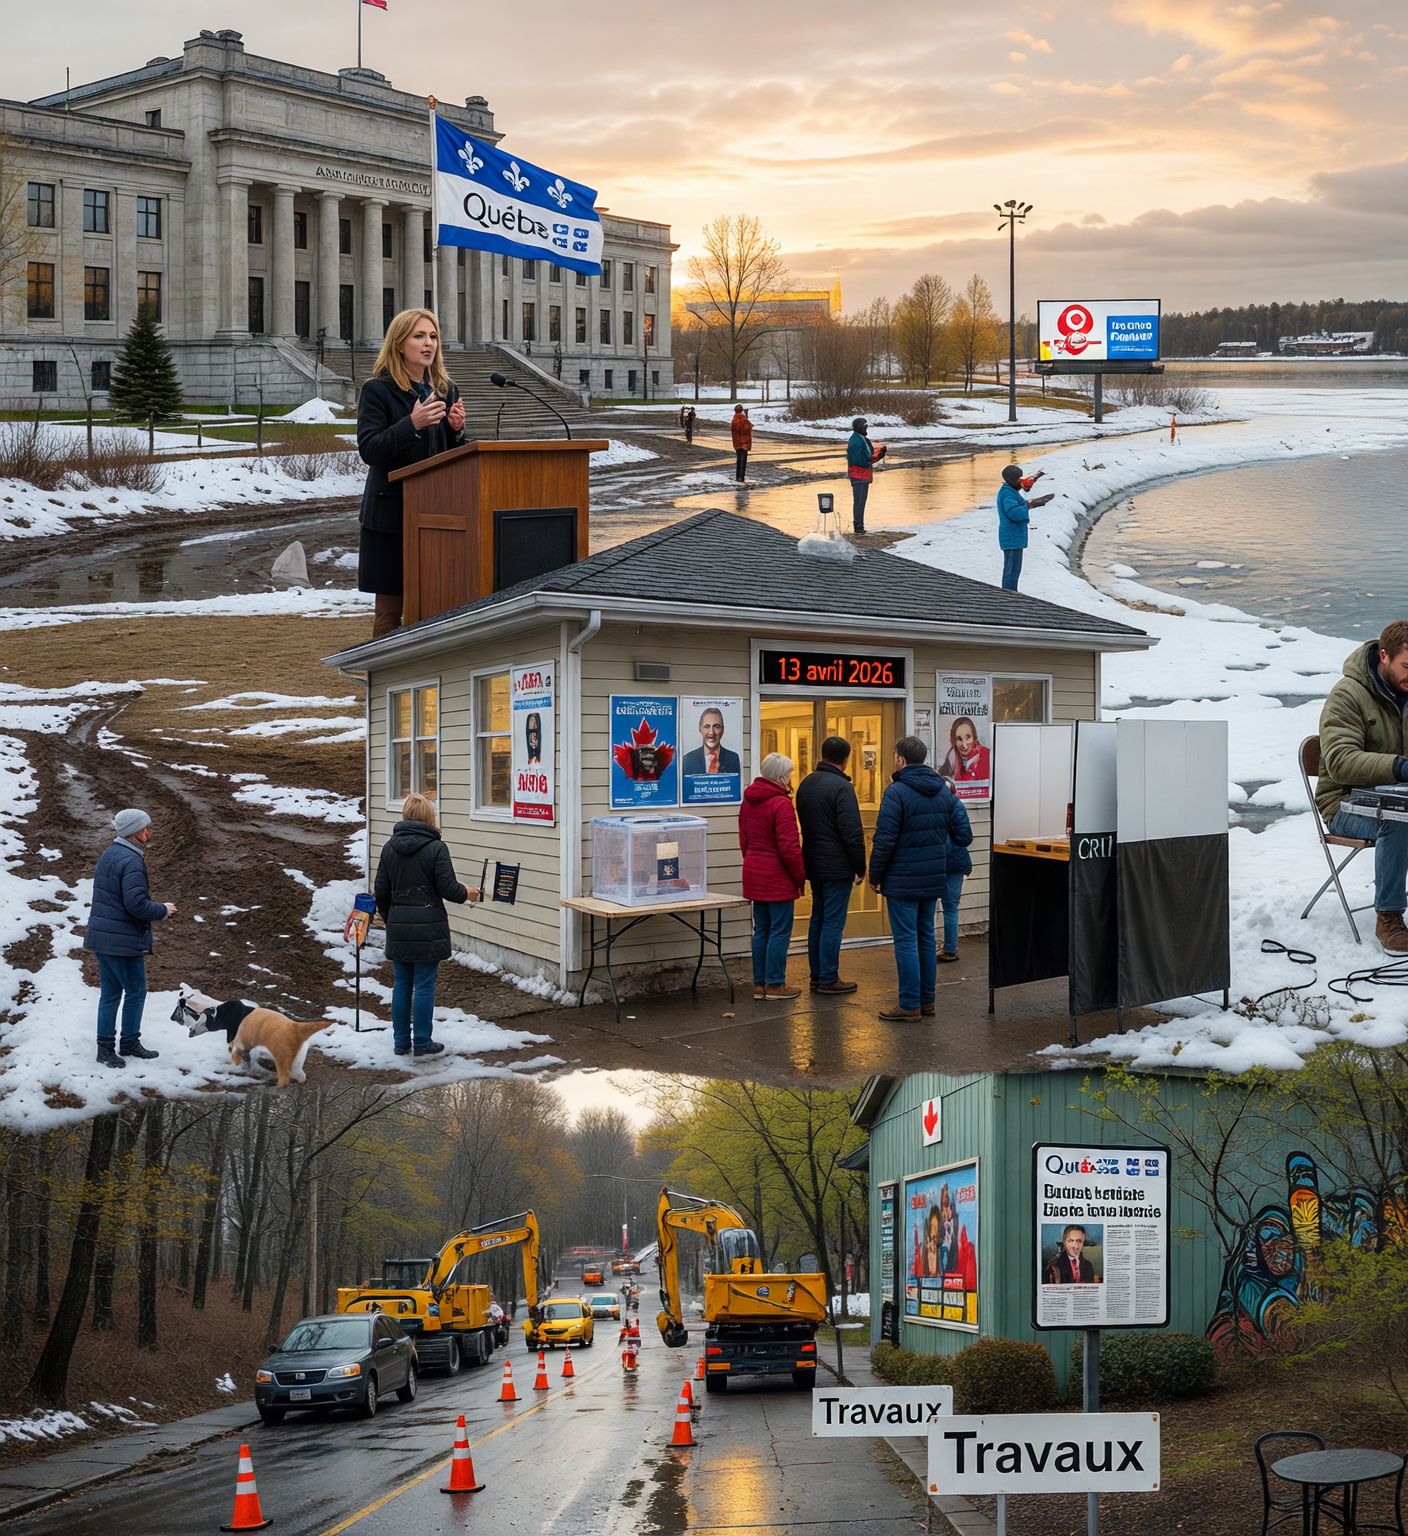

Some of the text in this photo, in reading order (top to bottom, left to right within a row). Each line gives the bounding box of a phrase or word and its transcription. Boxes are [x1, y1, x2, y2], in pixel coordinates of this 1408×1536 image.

[779, 657, 801, 681] 13
[849, 660, 893, 684] 2026
[819, 1397, 942, 1425] Travaux
[943, 1431, 1145, 1474] Travaux
